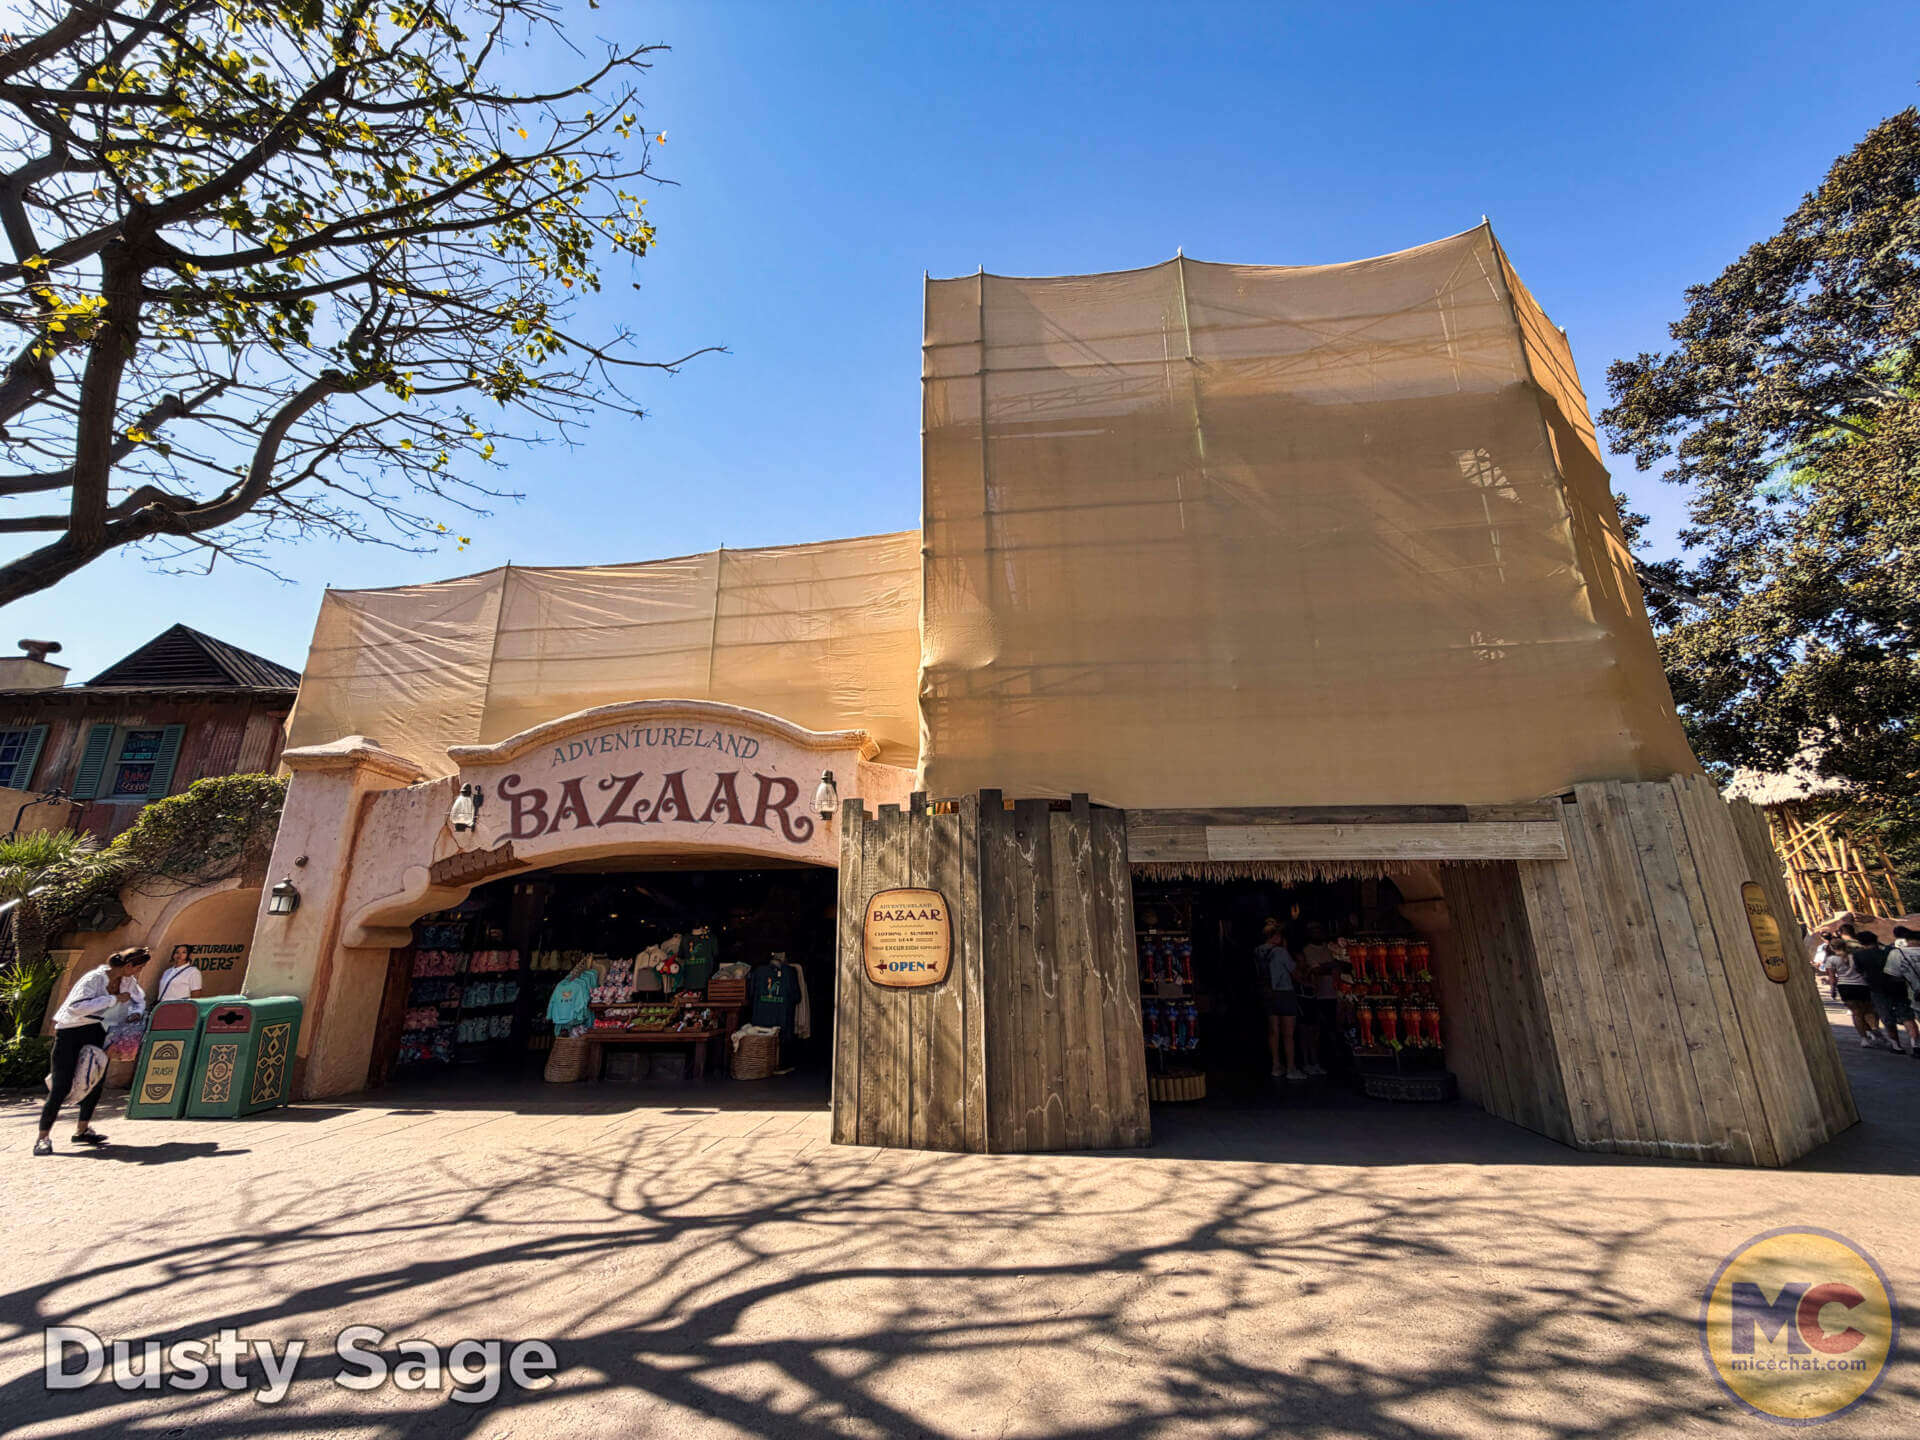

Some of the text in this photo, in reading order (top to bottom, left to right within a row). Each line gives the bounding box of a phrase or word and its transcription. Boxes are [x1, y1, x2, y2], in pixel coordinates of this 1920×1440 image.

[551, 727, 760, 767] ADVENTURELAND
[493, 769, 814, 847] BAZAAR
[873, 909, 943, 921] BAZAAR
[189, 944, 245, 954] ENTURELAND
[191, 957, 234, 971] ADERS
[889, 961, 926, 972] OPEN
[152, 1067, 175, 1077] TRASH
